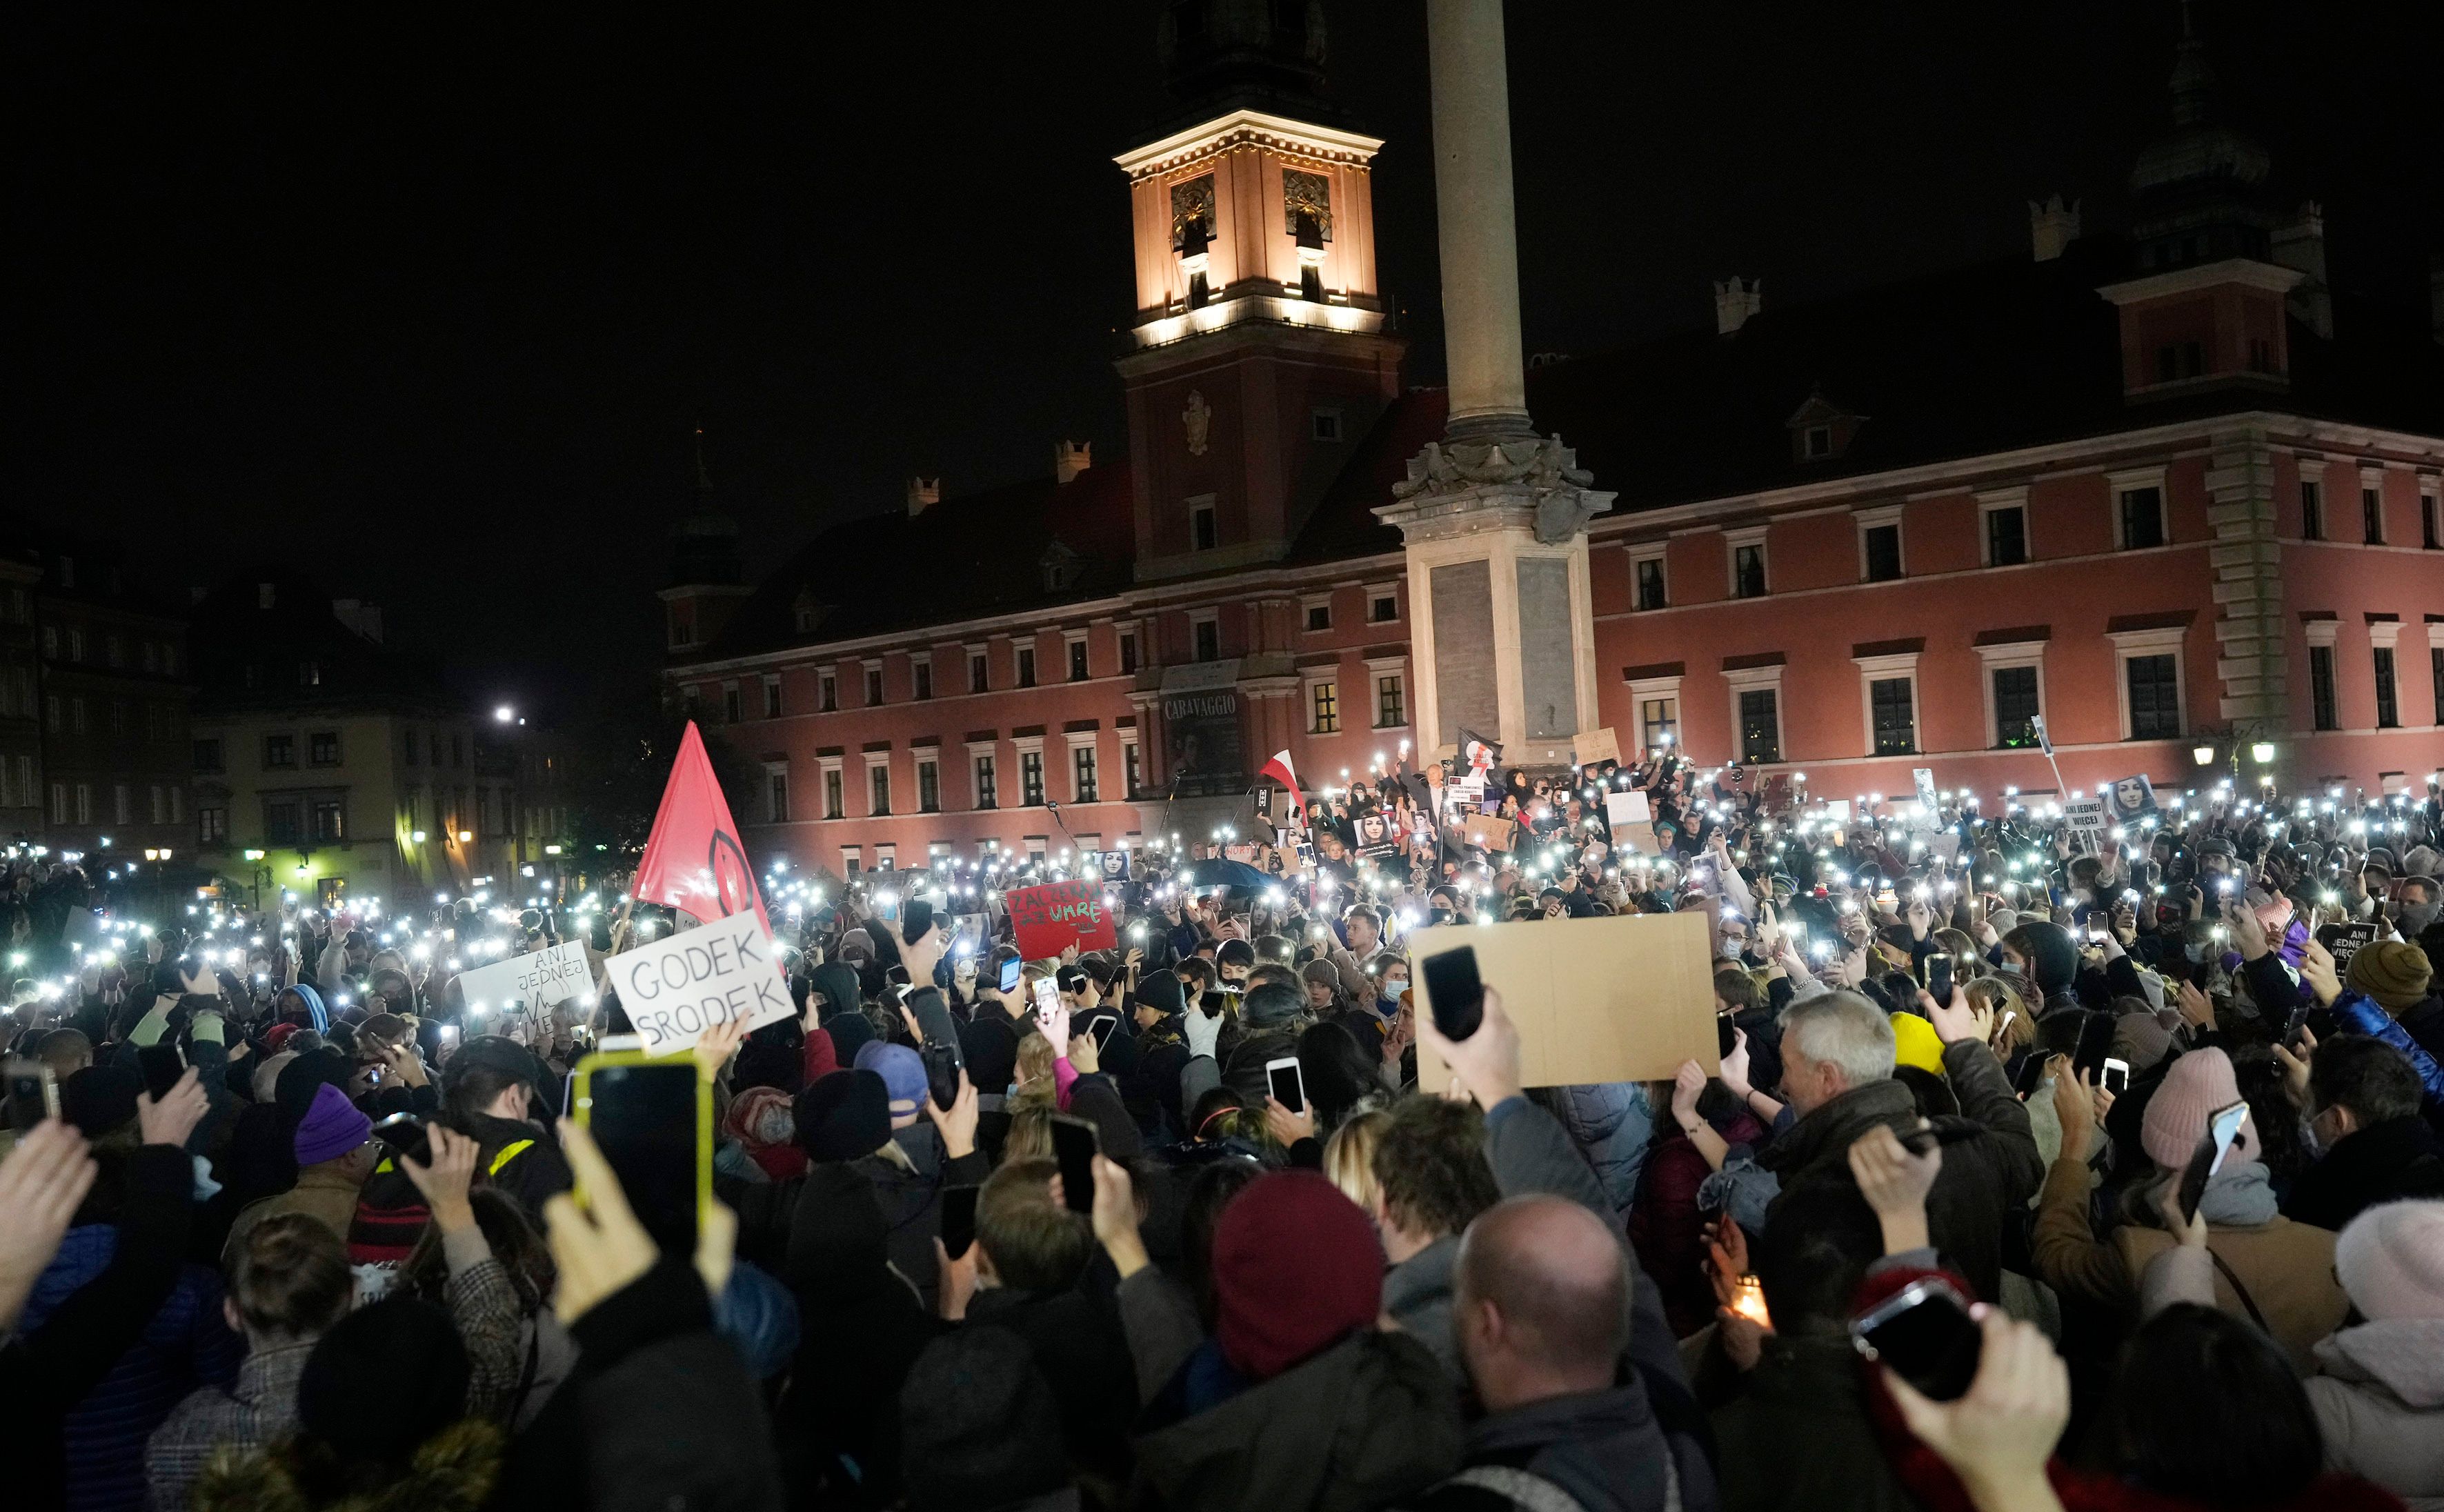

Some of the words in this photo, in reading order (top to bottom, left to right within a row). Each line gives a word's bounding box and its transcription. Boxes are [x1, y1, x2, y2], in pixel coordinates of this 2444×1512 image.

[1164, 694, 1236, 720] CARAVAGGIO
[2065, 805, 2076, 814] ANI
[2077, 803, 2101, 814] JEDNEJ
[2073, 815, 2098, 826] WIĘCEJ
[2350, 931, 2367, 939] ANI
[535, 945, 567, 968] ANI
[2332, 948, 2355, 959] WIĘC
[632, 930, 762, 999] GODEK
[517, 959, 584, 991] JEDNEJ
